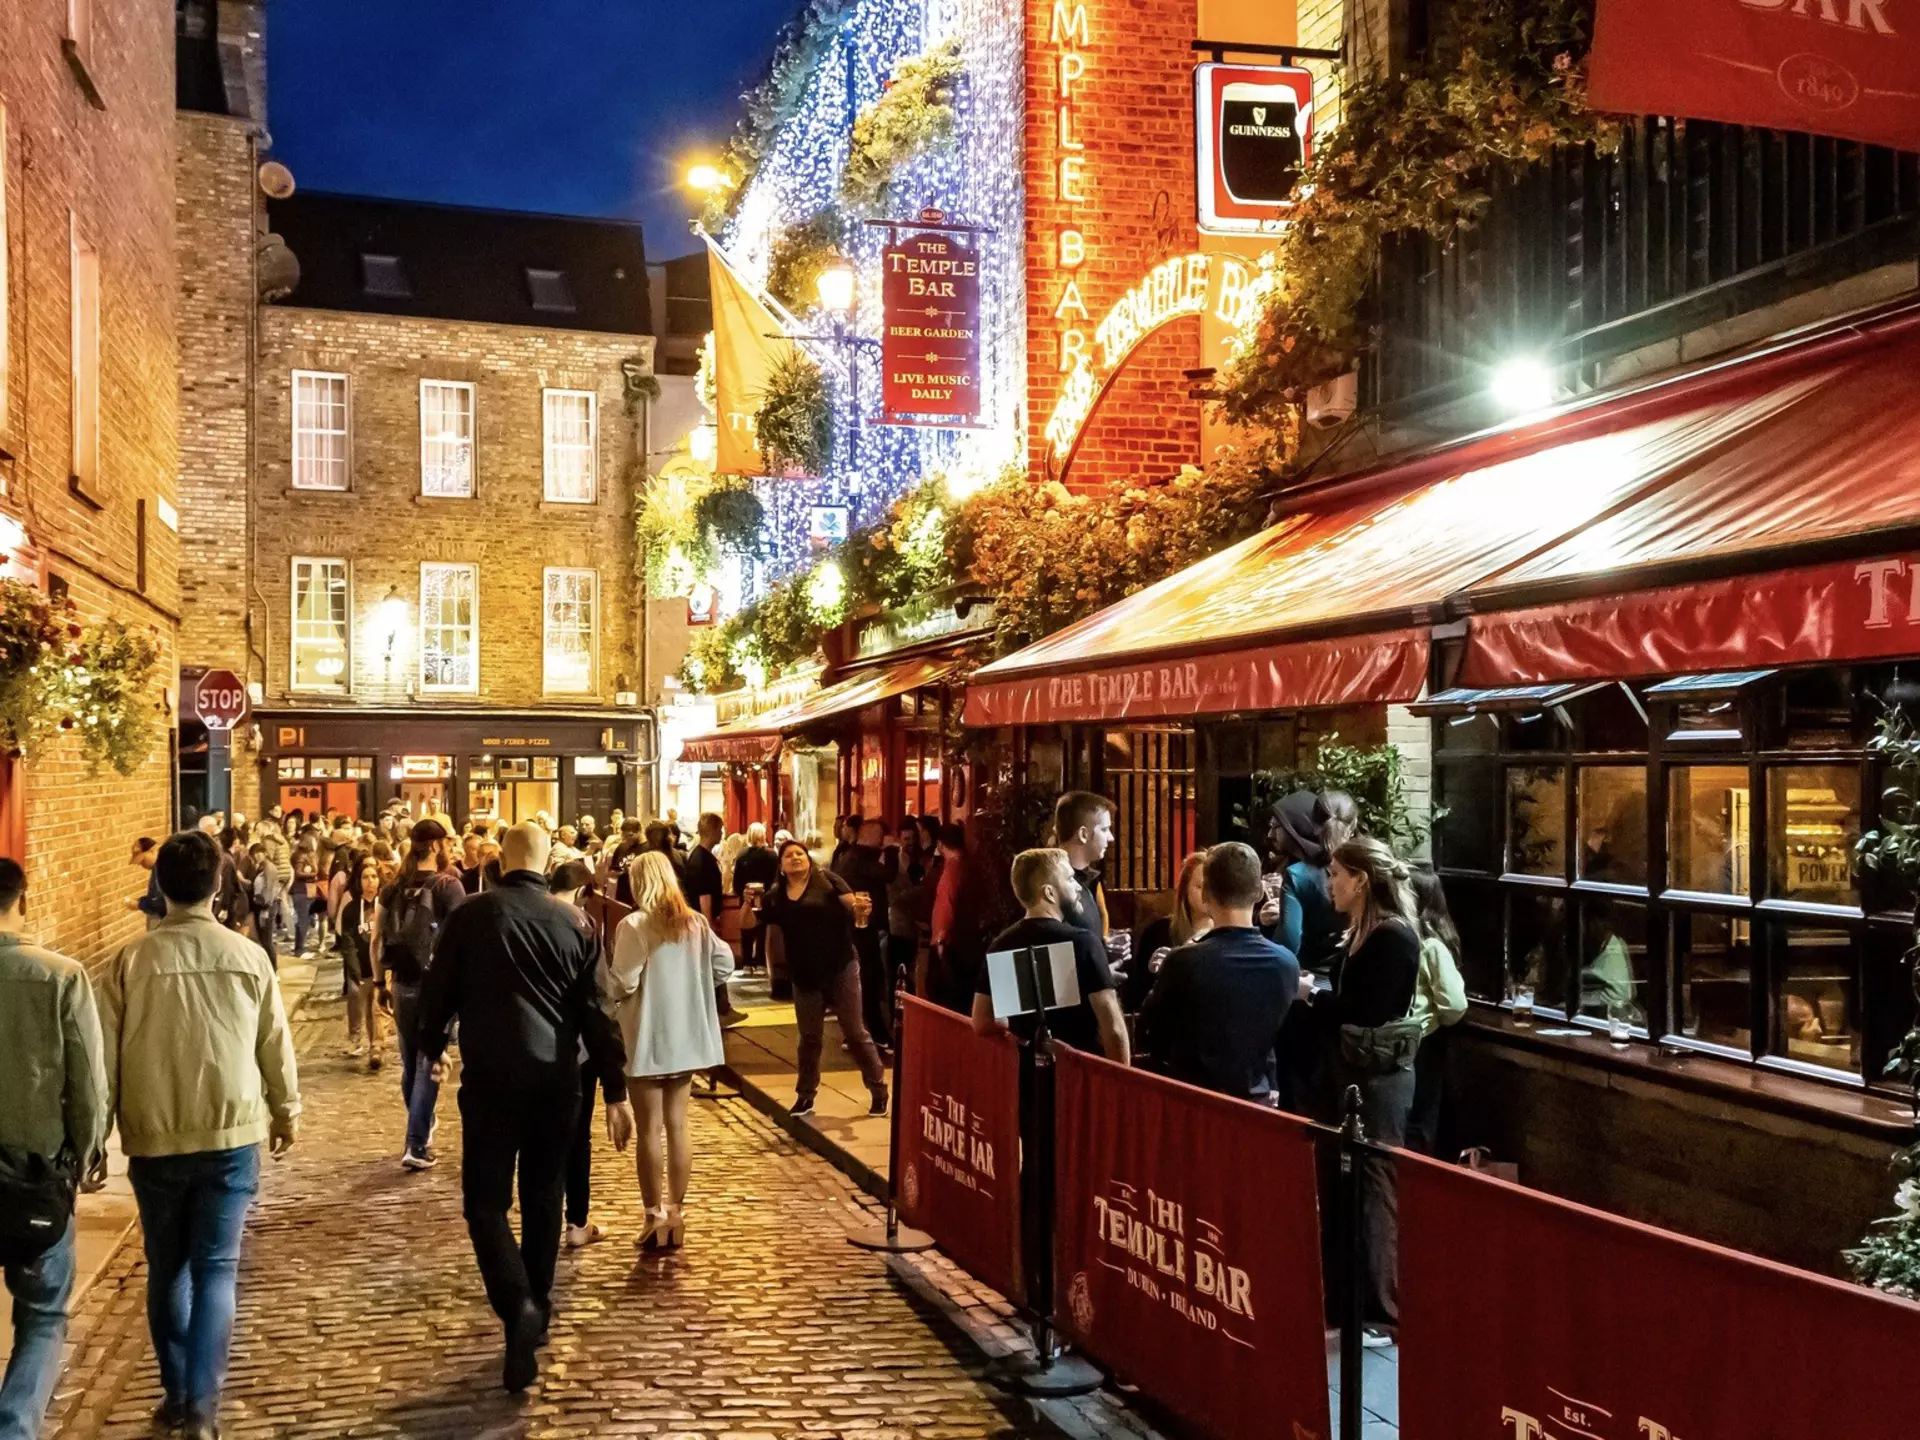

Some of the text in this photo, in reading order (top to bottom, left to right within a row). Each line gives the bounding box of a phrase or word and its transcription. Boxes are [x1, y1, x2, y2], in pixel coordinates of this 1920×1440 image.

[1229, 124, 1291, 138] GUINNESS
[917, 242, 947, 255] THE
[887, 253, 976, 277] TEMPLE
[908, 277, 956, 298] BAR
[1055, 230, 1089, 373] BAR
[890, 326, 974, 340] BEER GARDEN
[893, 373, 972, 386] LIVE MUSIC
[911, 388, 953, 400] DAILY
[1050, 677, 1083, 708] THE
[1088, 669, 1154, 706] TEMPLE
[1160, 662, 1200, 699] BAR
[199, 689, 242, 709] STOP
[279, 727, 305, 747] PI
[945, 1094, 966, 1128] THE
[920, 1105, 966, 1161] TEMPLE
[1194, 1250, 1255, 1321] BAR
[1563, 1405, 1592, 1427] Est.
